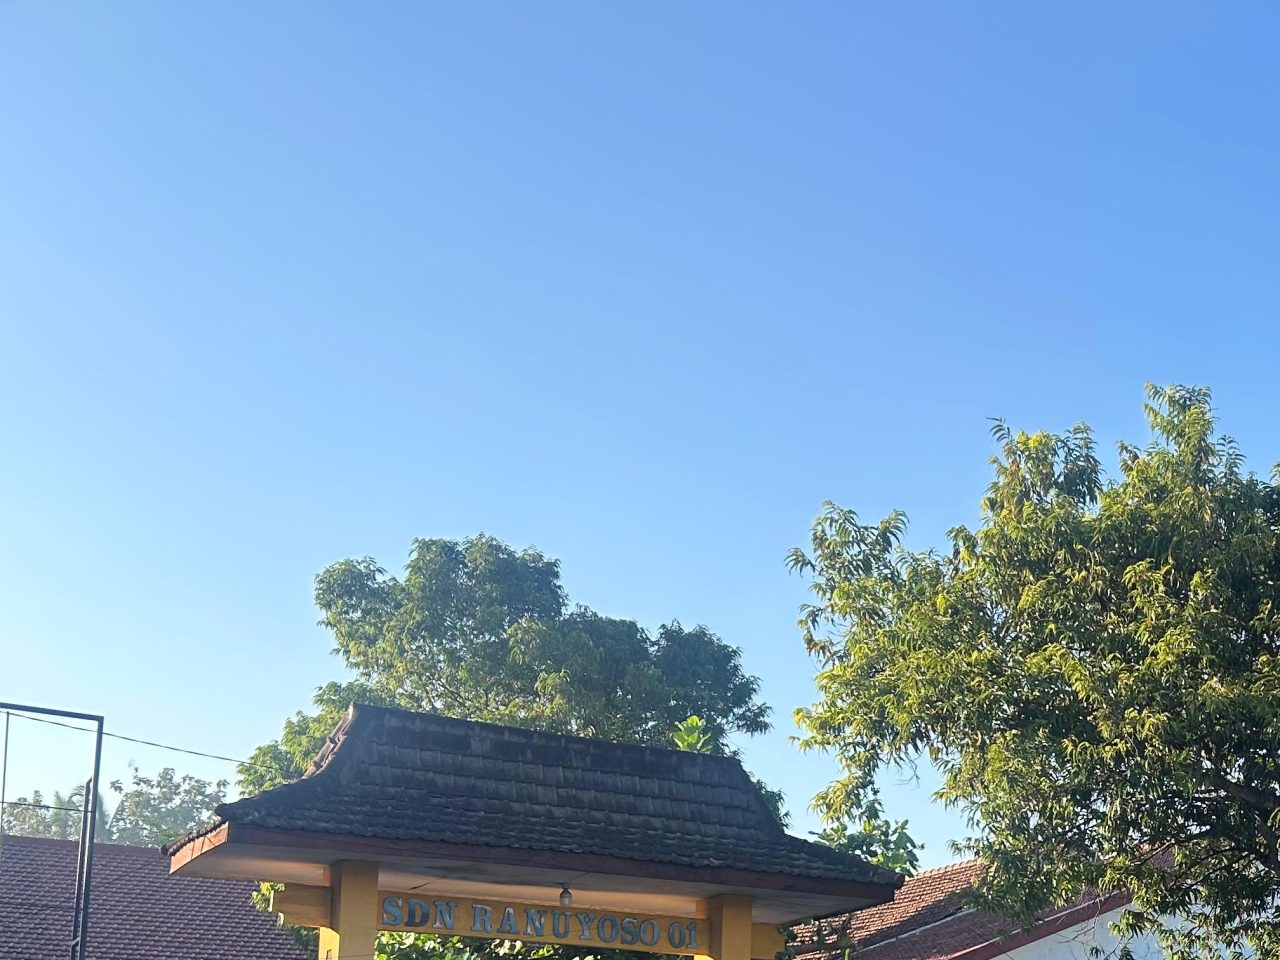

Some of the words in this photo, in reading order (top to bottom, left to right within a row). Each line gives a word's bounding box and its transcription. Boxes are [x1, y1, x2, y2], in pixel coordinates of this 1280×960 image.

[382, 896, 457, 929] SDN
[471, 904, 660, 946] RANUYOSO
[668, 922, 698, 949] 01
